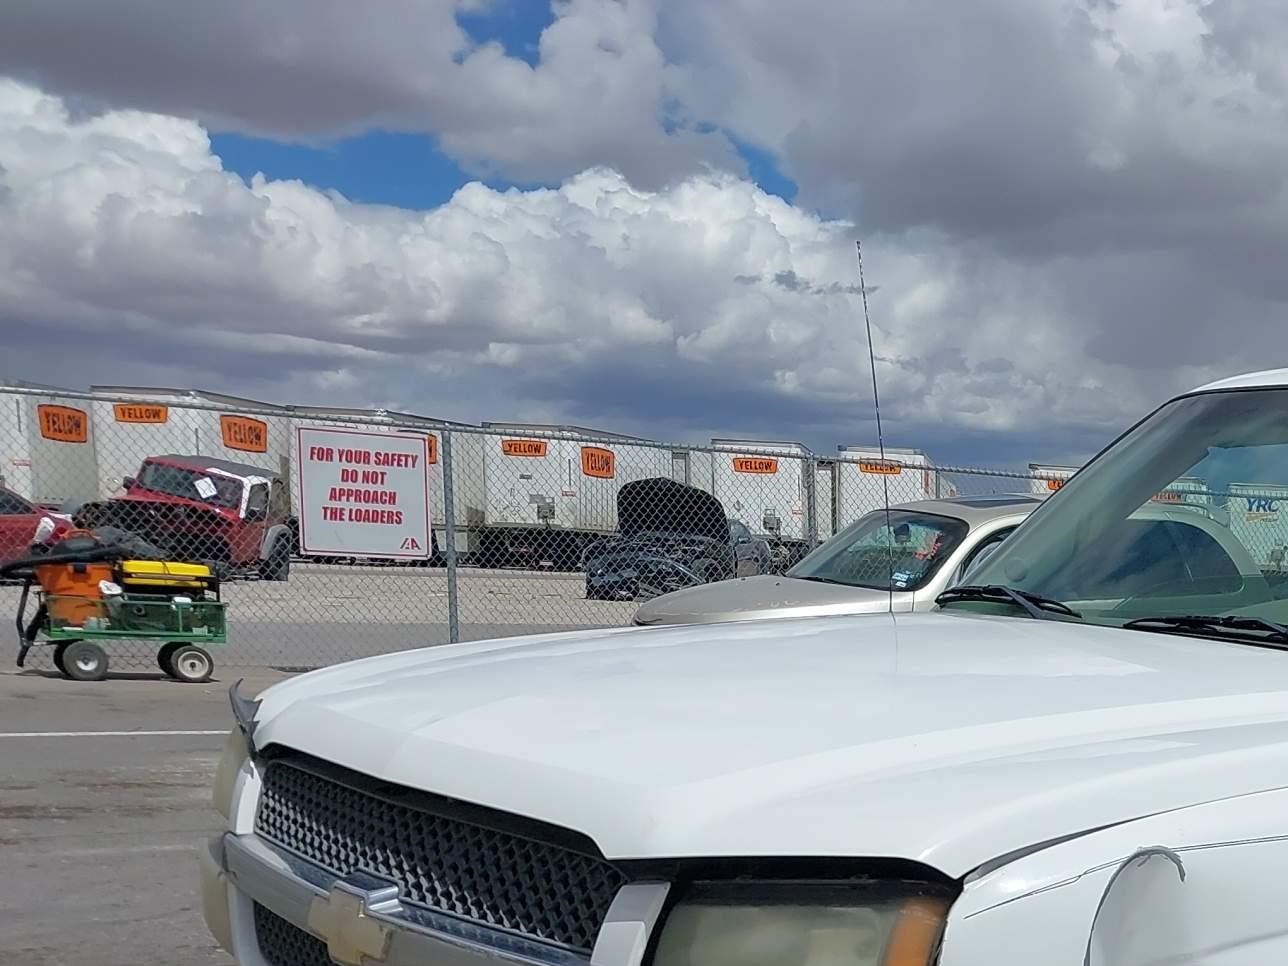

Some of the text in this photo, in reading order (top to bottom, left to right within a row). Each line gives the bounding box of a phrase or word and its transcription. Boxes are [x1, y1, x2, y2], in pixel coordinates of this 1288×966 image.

[120, 406, 161, 420] YELLOW
[44, 410, 81, 435] YELLOW
[226, 423, 262, 446] YELLOW
[507, 442, 541, 454] YELLOW
[309, 446, 419, 469] FOR YOUR SAFETY
[586, 452, 611, 473] YELLOW
[738, 459, 773, 471] YELLOW
[341, 468, 387, 485] DO NOT
[328, 487, 397, 505] APPROACH
[322, 506, 403, 525] THE LOADERS
